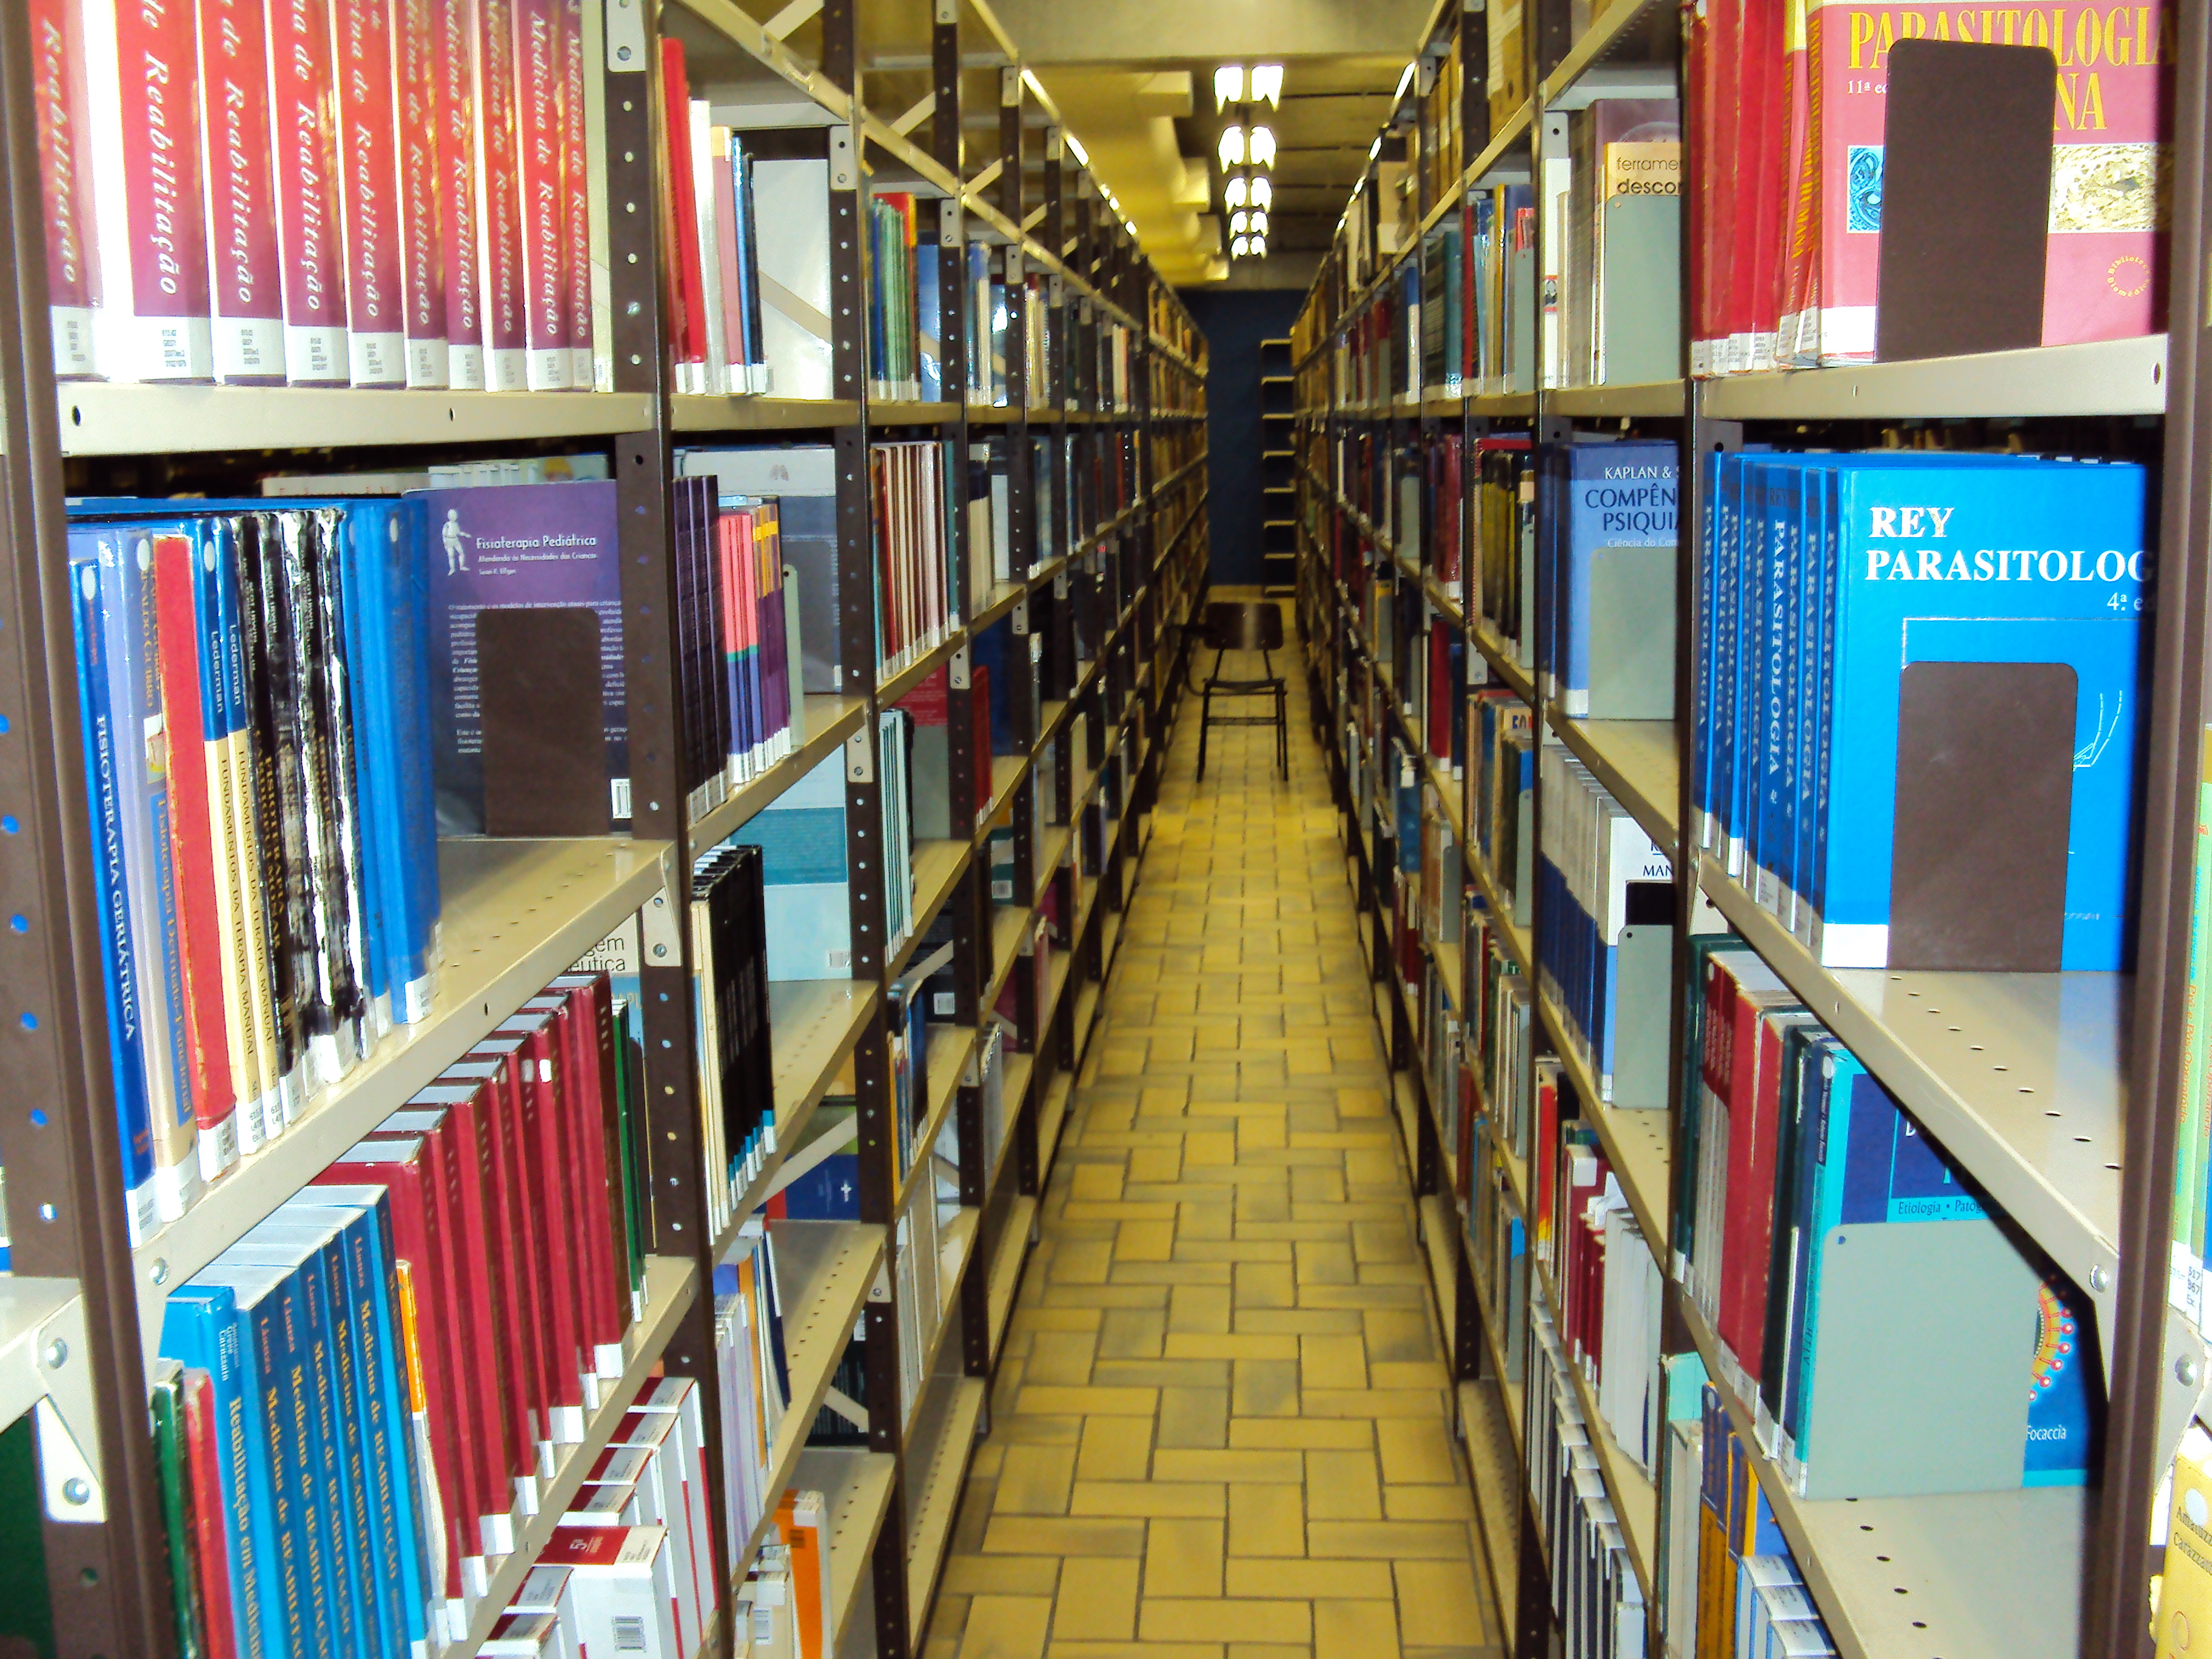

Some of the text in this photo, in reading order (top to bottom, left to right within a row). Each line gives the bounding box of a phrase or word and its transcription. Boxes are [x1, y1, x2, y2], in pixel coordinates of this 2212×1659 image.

[221, 17, 241, 58] de
[293, 42, 313, 82] de
[529, 11, 549, 132] Medicina
[352, 68, 369, 104] de
[407, 92, 422, 126] de
[567, 30, 583, 144] Medicina
[144, 50, 179, 295] Reabilitação
[444, 0, 474, 330] edicina de Reabilitação
[492, 124, 505, 154] de
[535, 137, 552, 166] de
[570, 150, 584, 176] de
[1617, 156, 1680, 171] ferrame
[224, 77, 255, 303] Reabilitação
[295, 99, 323, 311] Reabilitação
[355, 121, 380, 318] Reabilitação
[1617, 178, 1682, 194] desco
[409, 142, 431, 326] Reabilitação
[495, 169, 513, 333] Reabilitação
[537, 180, 558, 337] Reabilitação
[571, 190, 588, 338] Reabilitação
[1585, 483, 1677, 509] COMPÊN
[1604, 466, 1672, 480] KAPLAN &
[475, 533, 598, 551] Fisioterapia Pediátrica
[1603, 512, 1678, 535] PSIQUI
[1658, 537, 1678, 547] Com
[1868, 506, 1956, 539] REY
[1864, 549, 2156, 583] PARASITOLOG
[210, 630, 223, 714] Lederman
[229, 623, 241, 706] Lederman
[1769, 519, 1787, 776] PARASITOLOGIA
[96, 713, 136, 1041] FISIOTERAPIA GERIÁTRICA
[221, 759, 237, 883] FUNDAMENTOS
[232, 887, 241, 914] DA
[241, 990, 255, 1057] MANUAL
[238, 750, 255, 873] FUNDAMENTOS
[250, 877, 258, 902] DA
[260, 979, 273, 1048] MANUAL
[1642, 864, 1672, 877] MAN
[1898, 1199, 1983, 1216] Etiologia Patog
[337, 1319, 352, 1417] Medicina
[347, 1421, 357, 1447] de
[360, 1299, 375, 1396] Medicina
[370, 1399, 380, 1425] de
[291, 1364, 307, 1468] Medicina
[301, 1472, 312, 1500] de
[314, 1340, 330, 1440] Medicina
[324, 1445, 333, 1472] de
[2026, 1424, 2067, 1441] Focaccia
[267, 1386, 283, 1493] Medicina
[276, 1497, 289, 1526] de
[228, 1396, 249, 1532] Reabilitação
[244, 1569, 261, 1659] Medicin
[2176, 1506, 2212, 1547] Amatuzz
